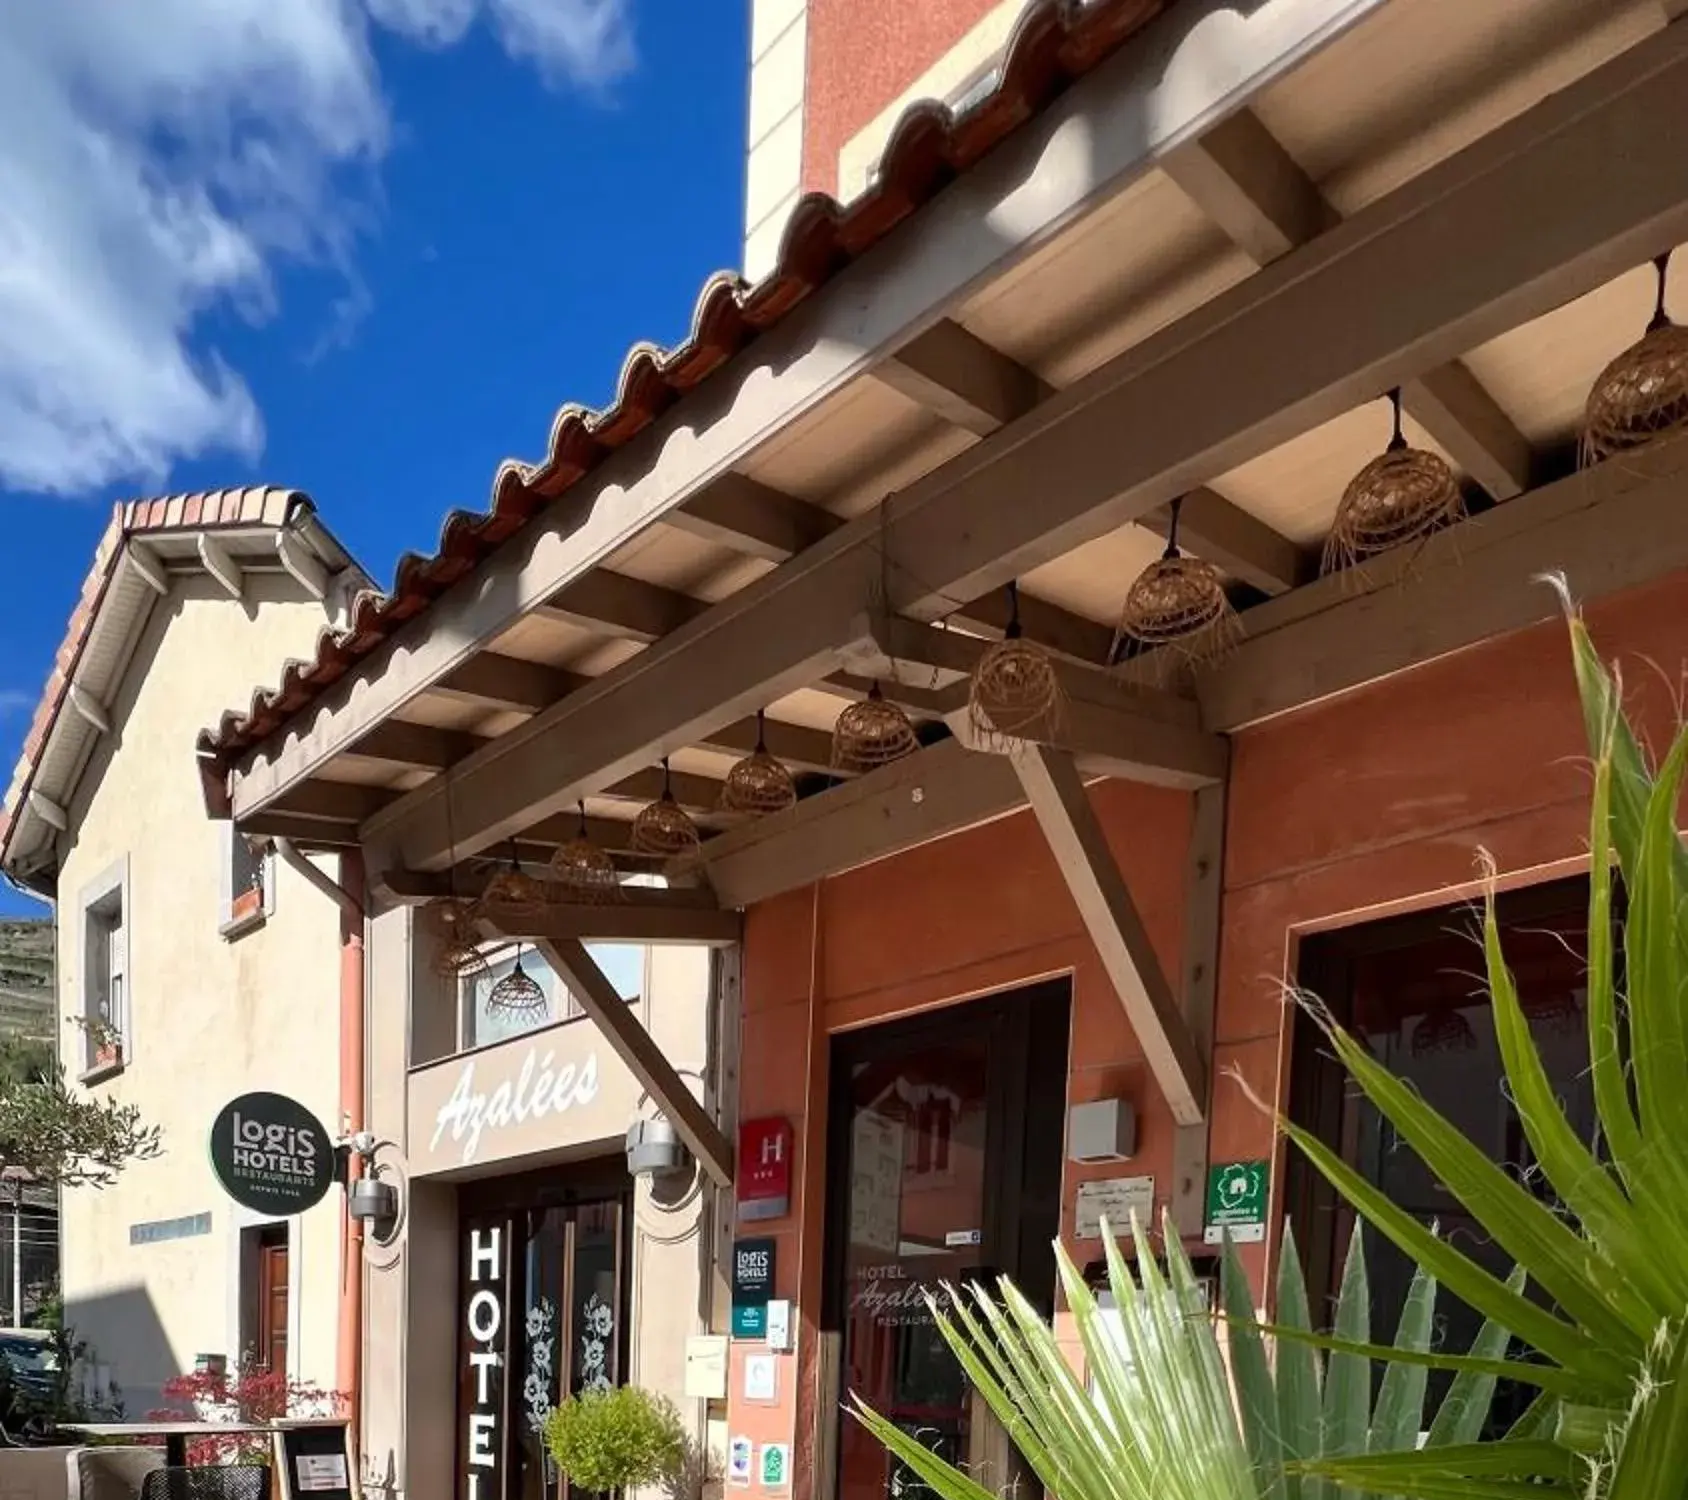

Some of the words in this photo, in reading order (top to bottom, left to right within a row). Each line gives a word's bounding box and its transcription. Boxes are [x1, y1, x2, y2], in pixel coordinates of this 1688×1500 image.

[429, 1046, 600, 1164] Azalées
[233, 1148, 315, 1177] HOTELS
[762, 1133, 782, 1164] H
[858, 1265, 907, 1279] HOTEL
